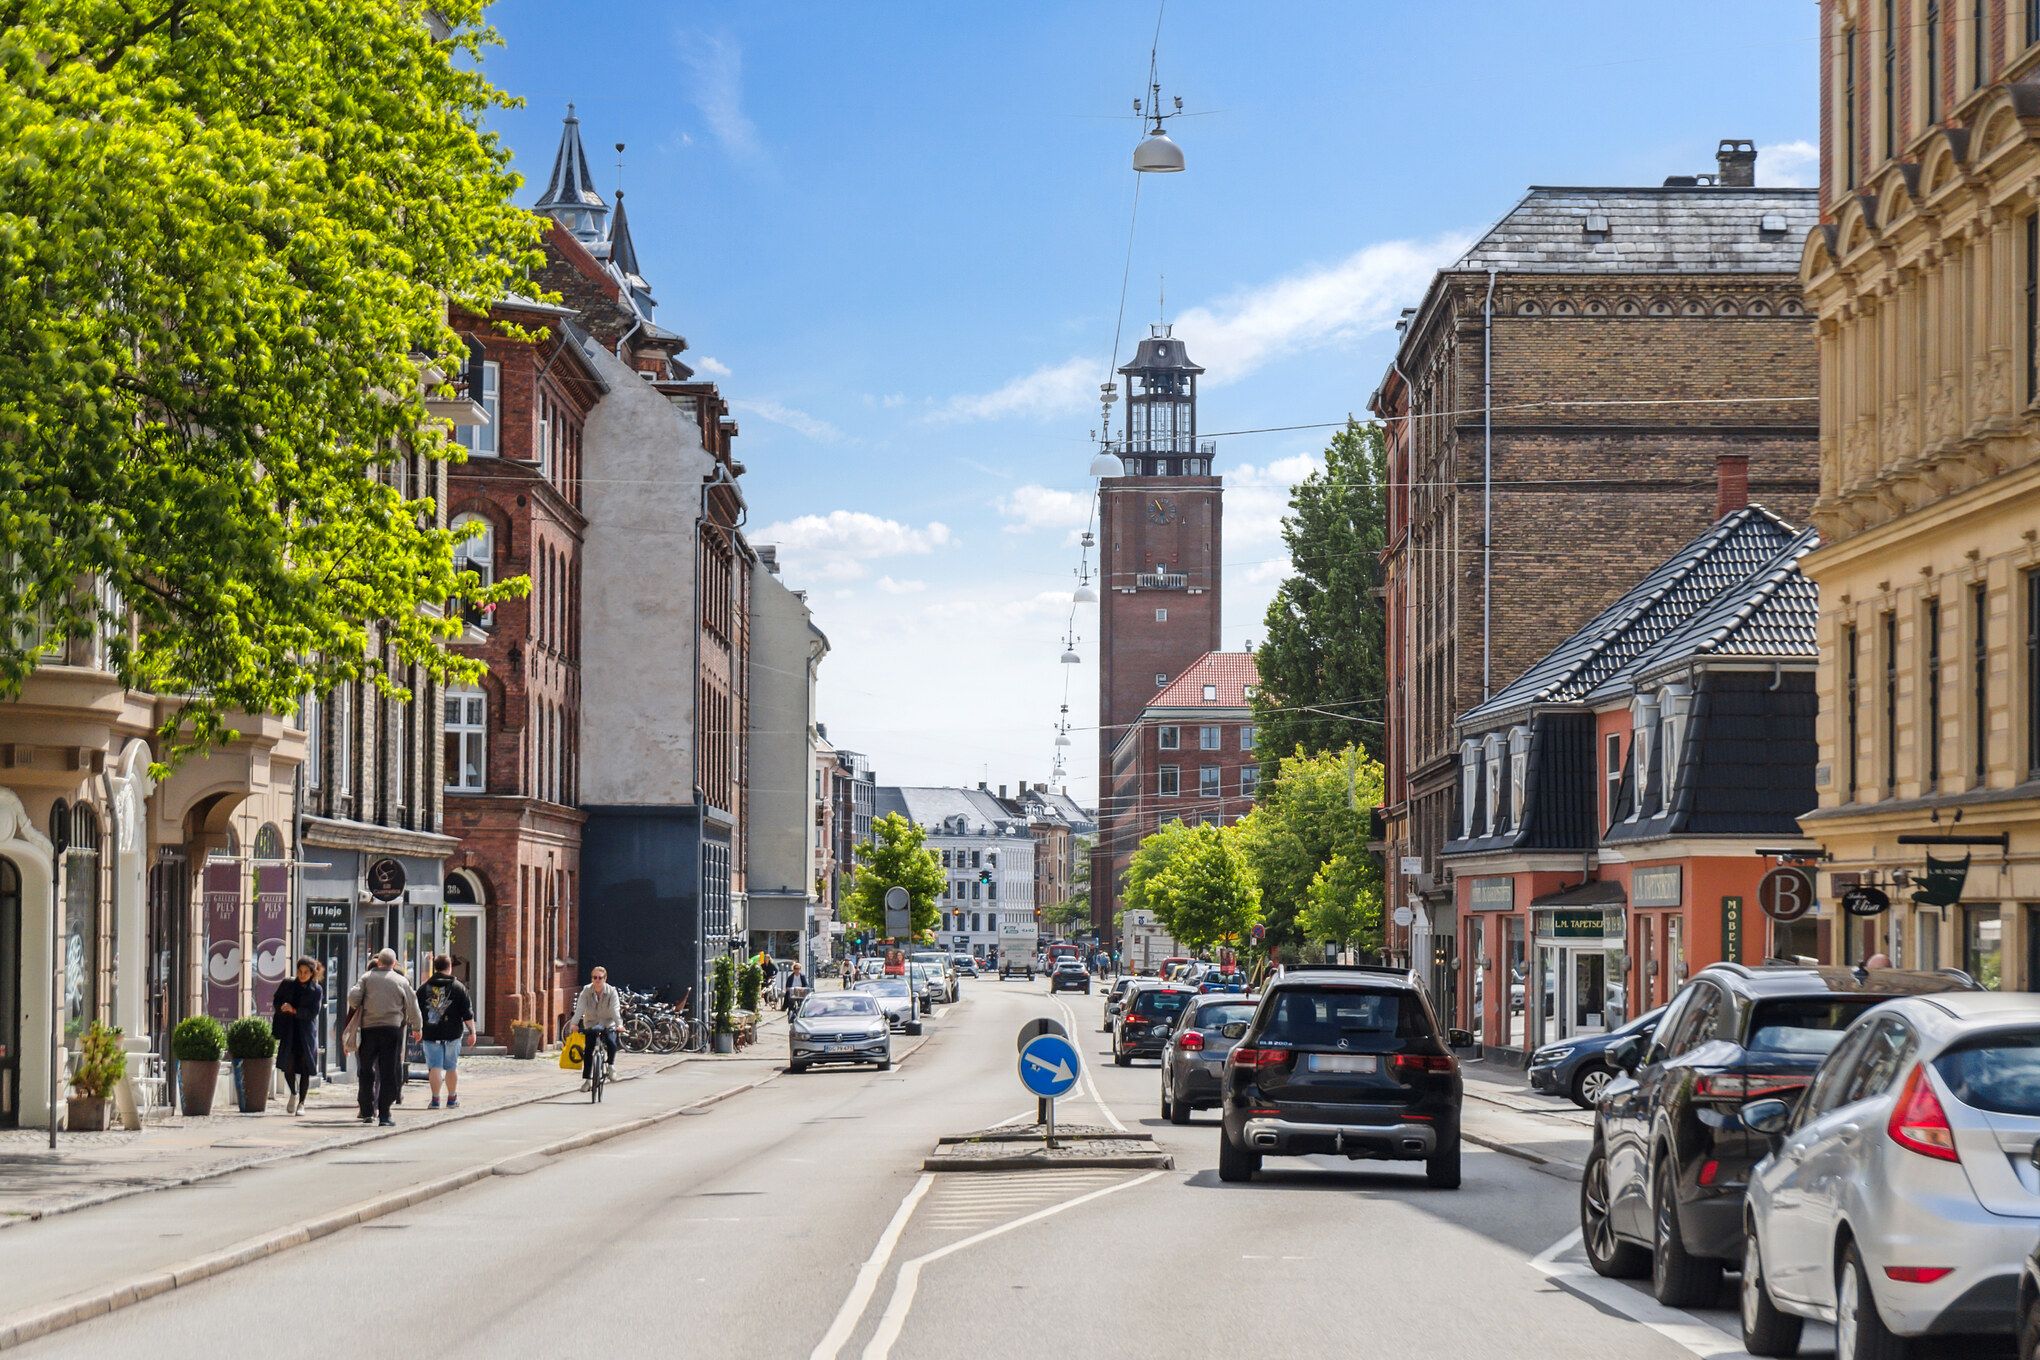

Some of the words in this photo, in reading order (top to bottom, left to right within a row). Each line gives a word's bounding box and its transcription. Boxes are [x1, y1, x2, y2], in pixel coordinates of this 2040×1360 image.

[1774, 875, 1801, 914] B
[216, 902, 234, 912] PULS
[264, 903, 282, 912] PULS
[1852, 900, 1880, 911] Elisa
[312, 906, 324, 916] Til
[325, 906, 342, 918] leje
